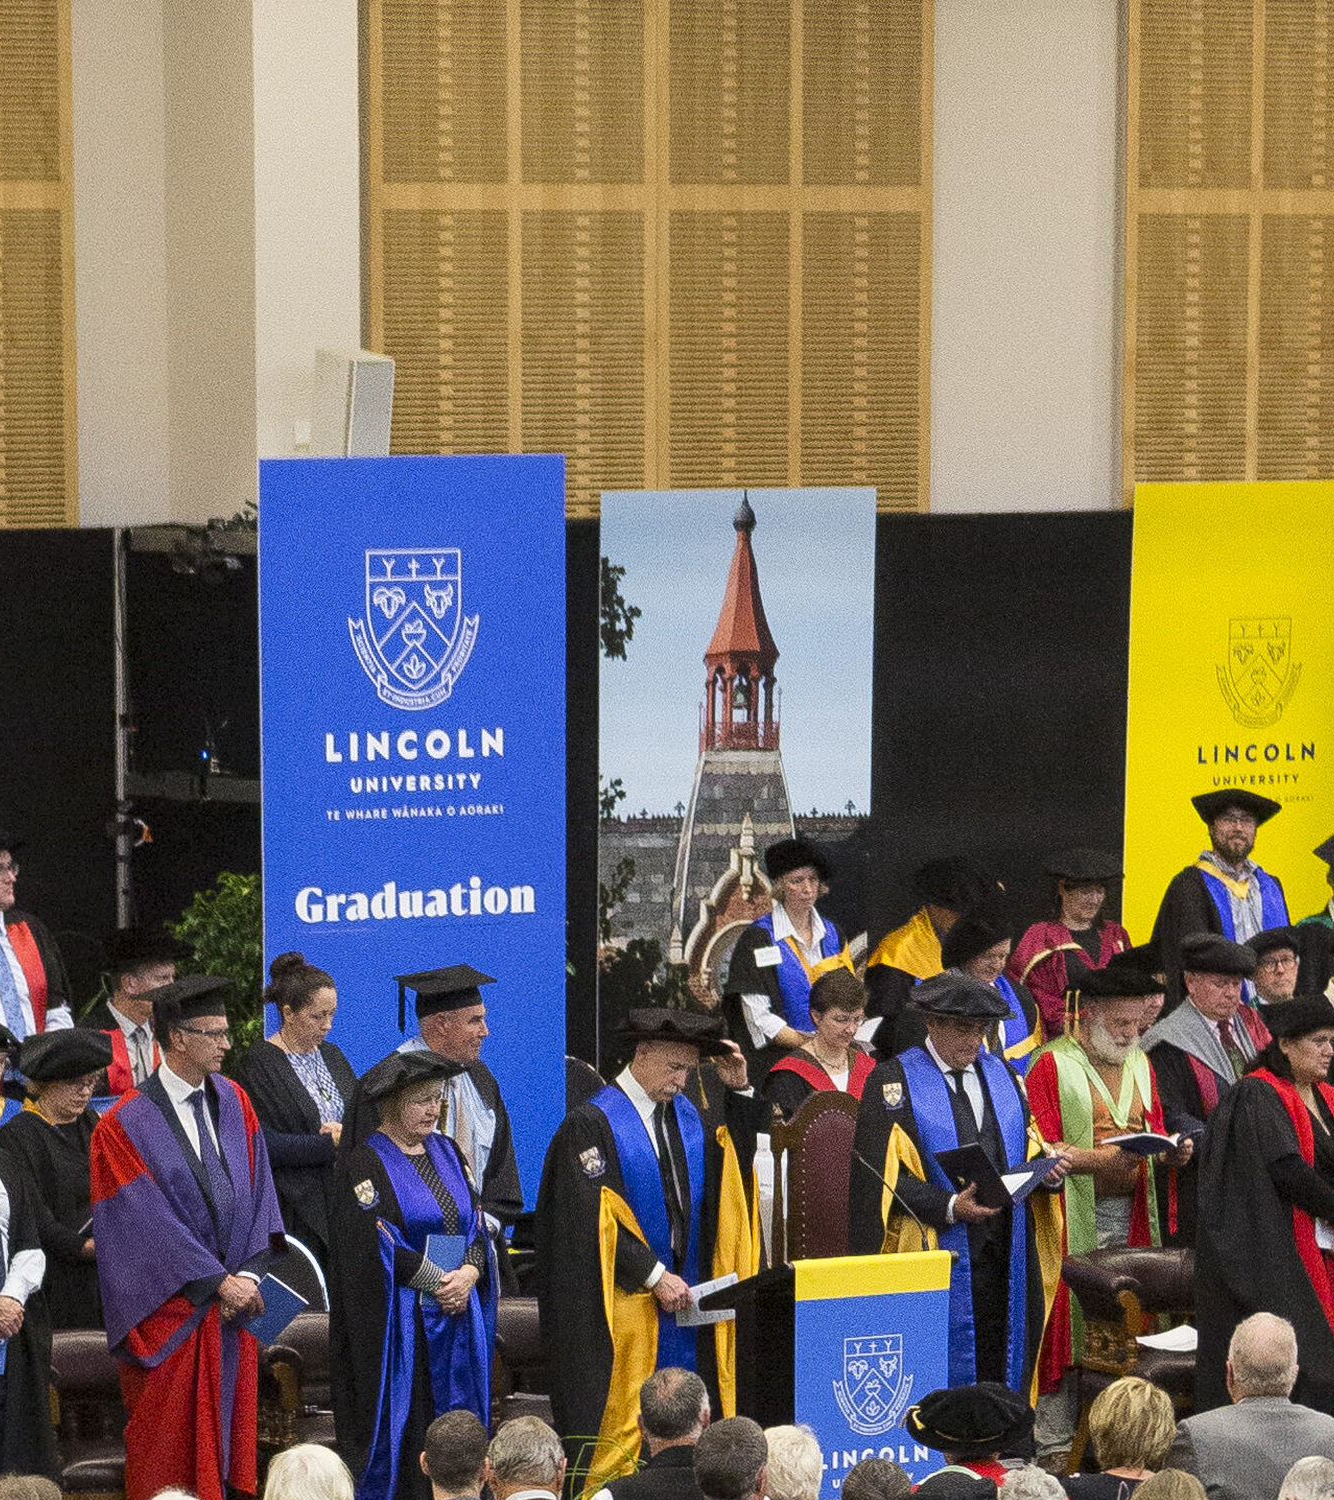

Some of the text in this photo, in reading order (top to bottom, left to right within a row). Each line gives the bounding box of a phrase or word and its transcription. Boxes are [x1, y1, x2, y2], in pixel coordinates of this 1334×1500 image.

[325, 727, 505, 763] LINCOLN
[1198, 742, 1315, 765] LINCOLN
[350, 773, 482, 794] UNIVERSITY
[1213, 773, 1299, 786] UNIVERSITY
[294, 875, 536, 925] Graduation
